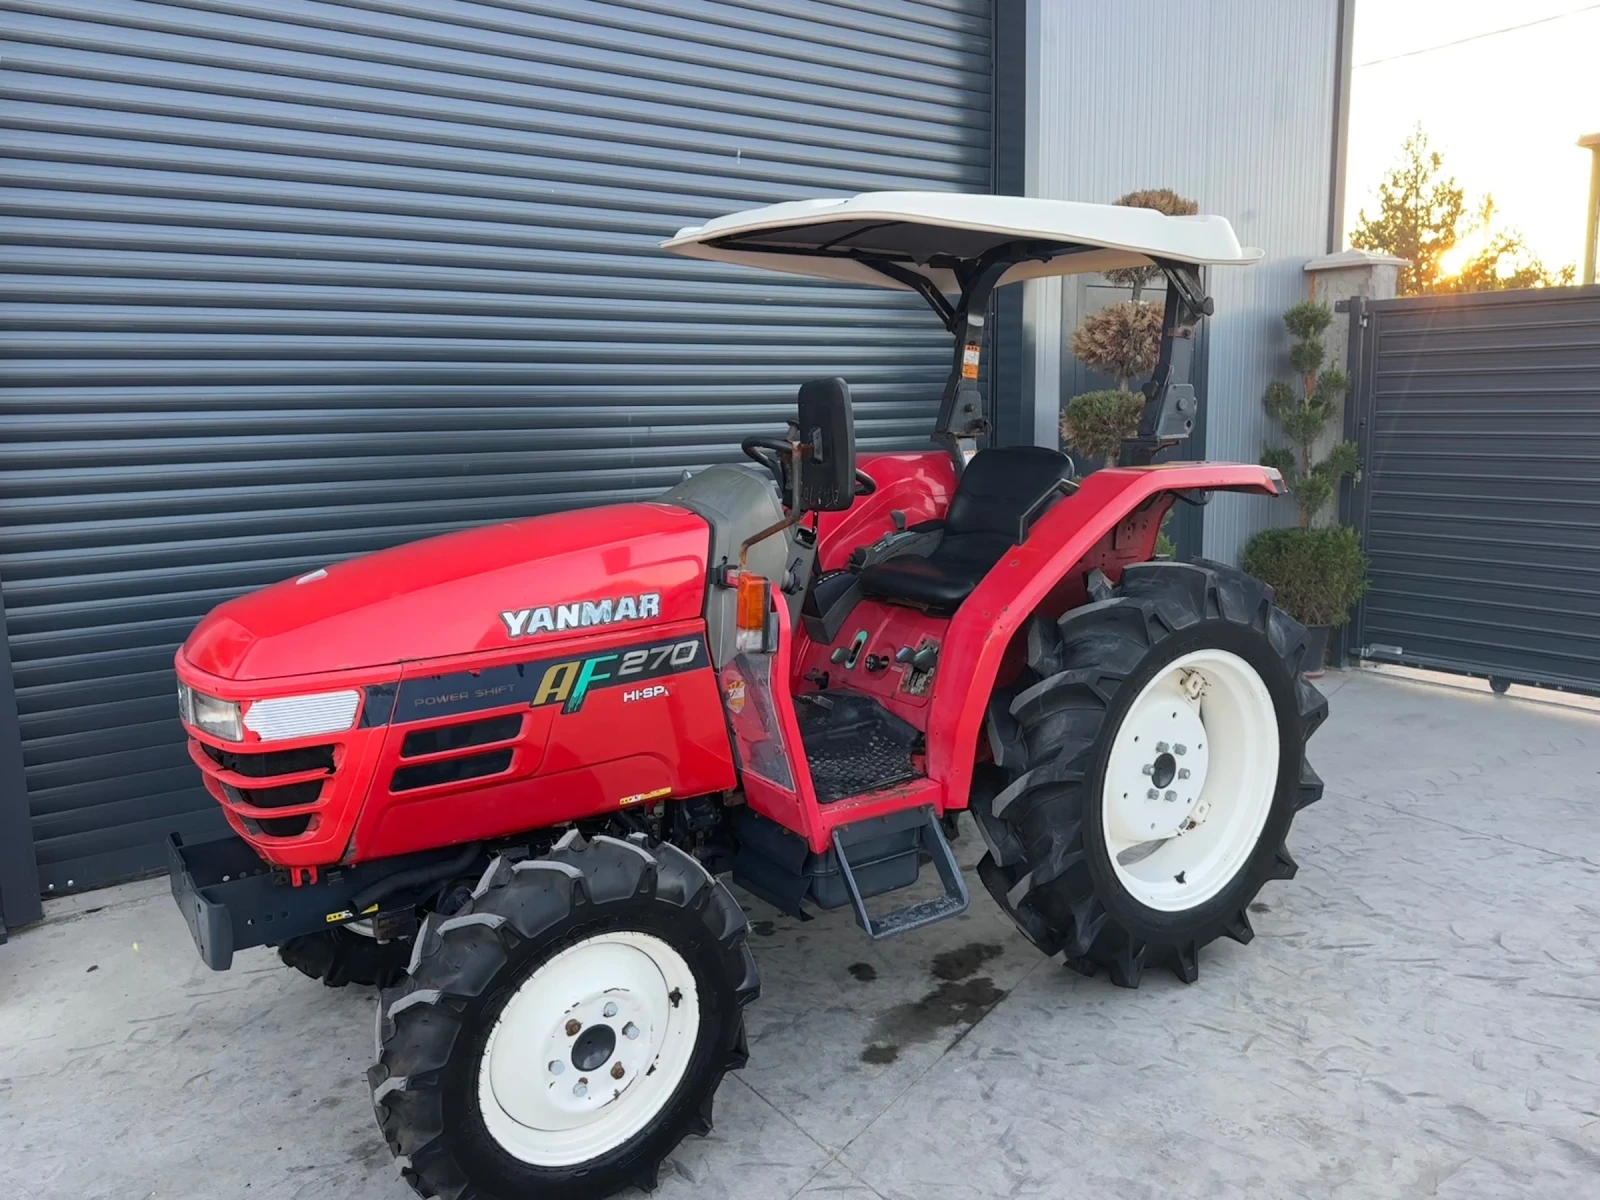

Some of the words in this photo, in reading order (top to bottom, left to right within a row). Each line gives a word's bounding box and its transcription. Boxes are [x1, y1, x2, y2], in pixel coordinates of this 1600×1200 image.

[501, 593, 660, 638] YANMAR
[414, 691, 469, 707] POWER
[474, 684, 516, 698] SHIFT
[532, 654, 618, 714] AF
[617, 640, 700, 677] 270
